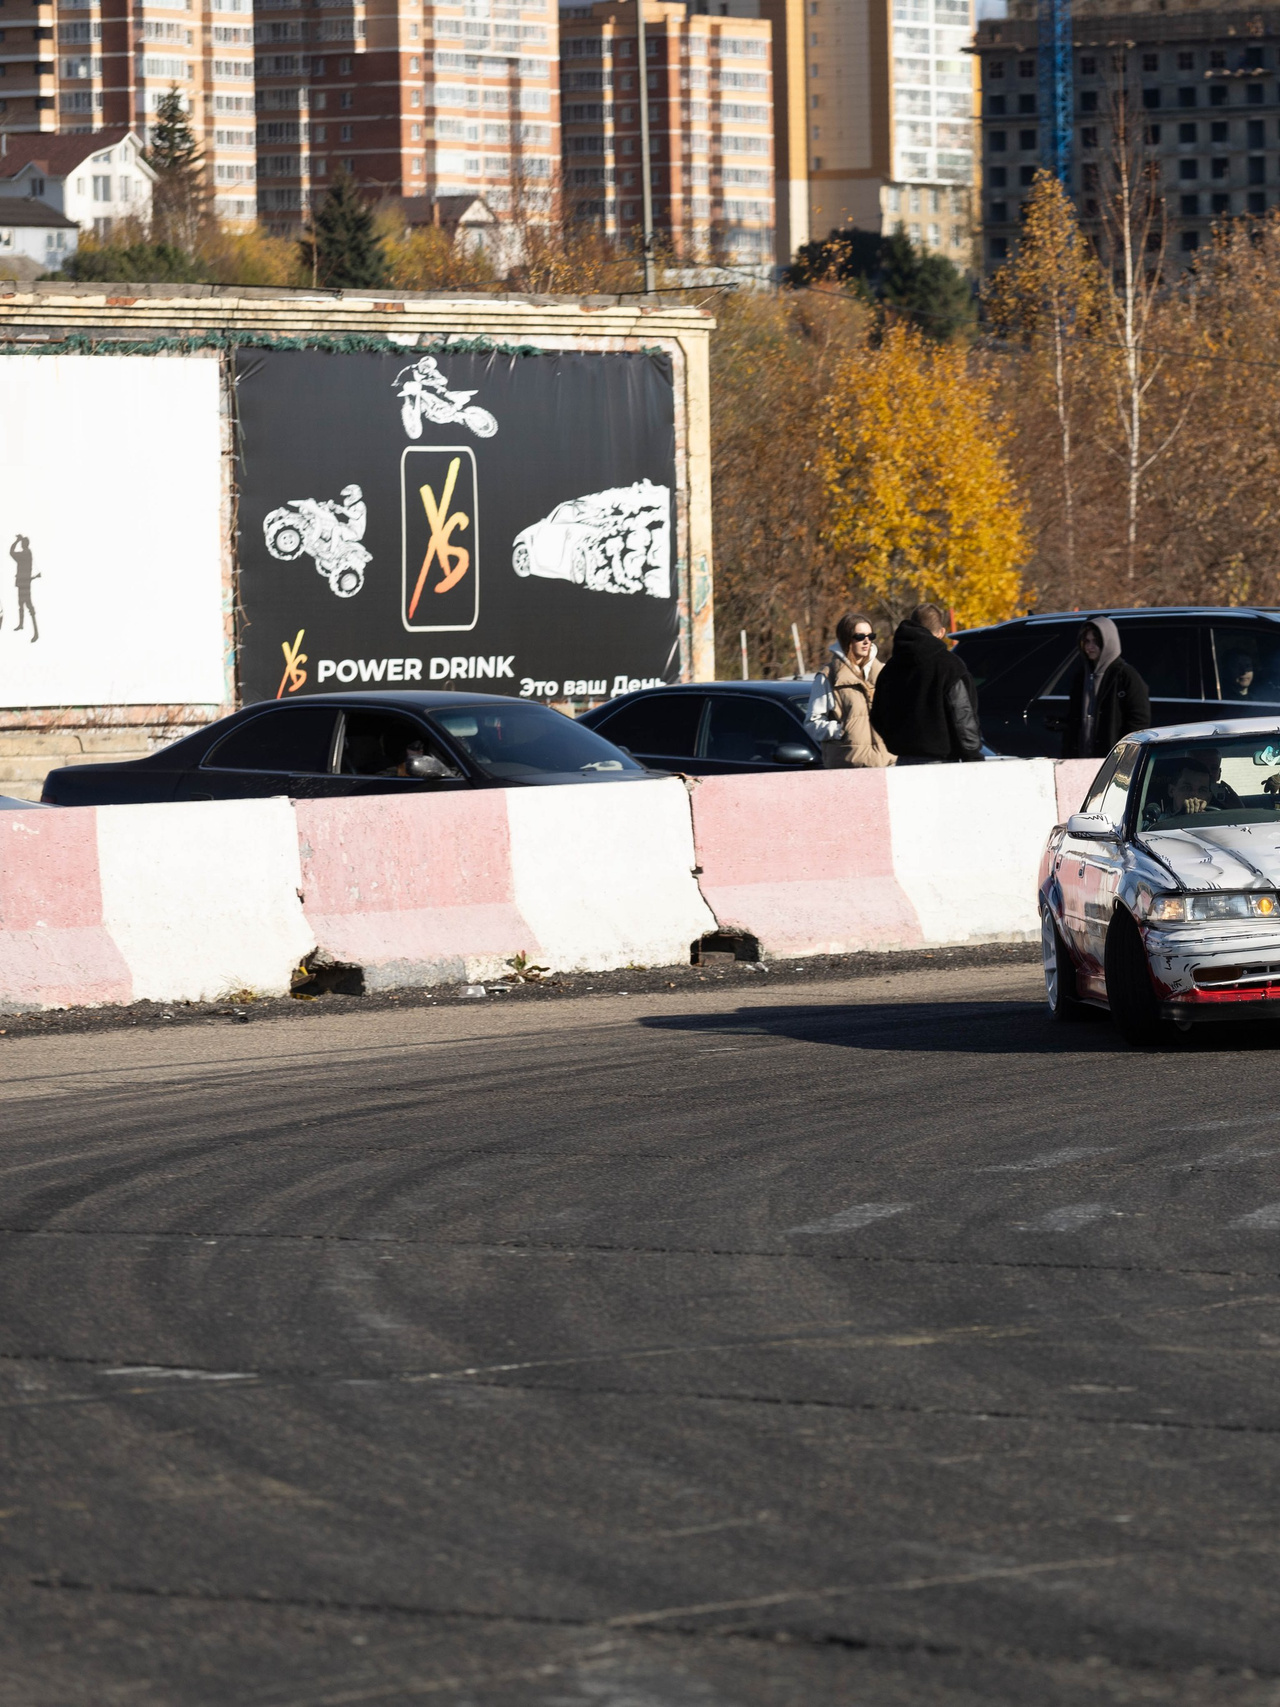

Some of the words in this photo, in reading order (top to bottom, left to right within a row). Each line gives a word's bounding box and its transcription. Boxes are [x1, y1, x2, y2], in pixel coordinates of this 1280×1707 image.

[317, 657, 423, 683] POWER
[429, 655, 516, 682] DRINK
[519, 677, 559, 697] Это
[563, 679, 608, 696] ваш
